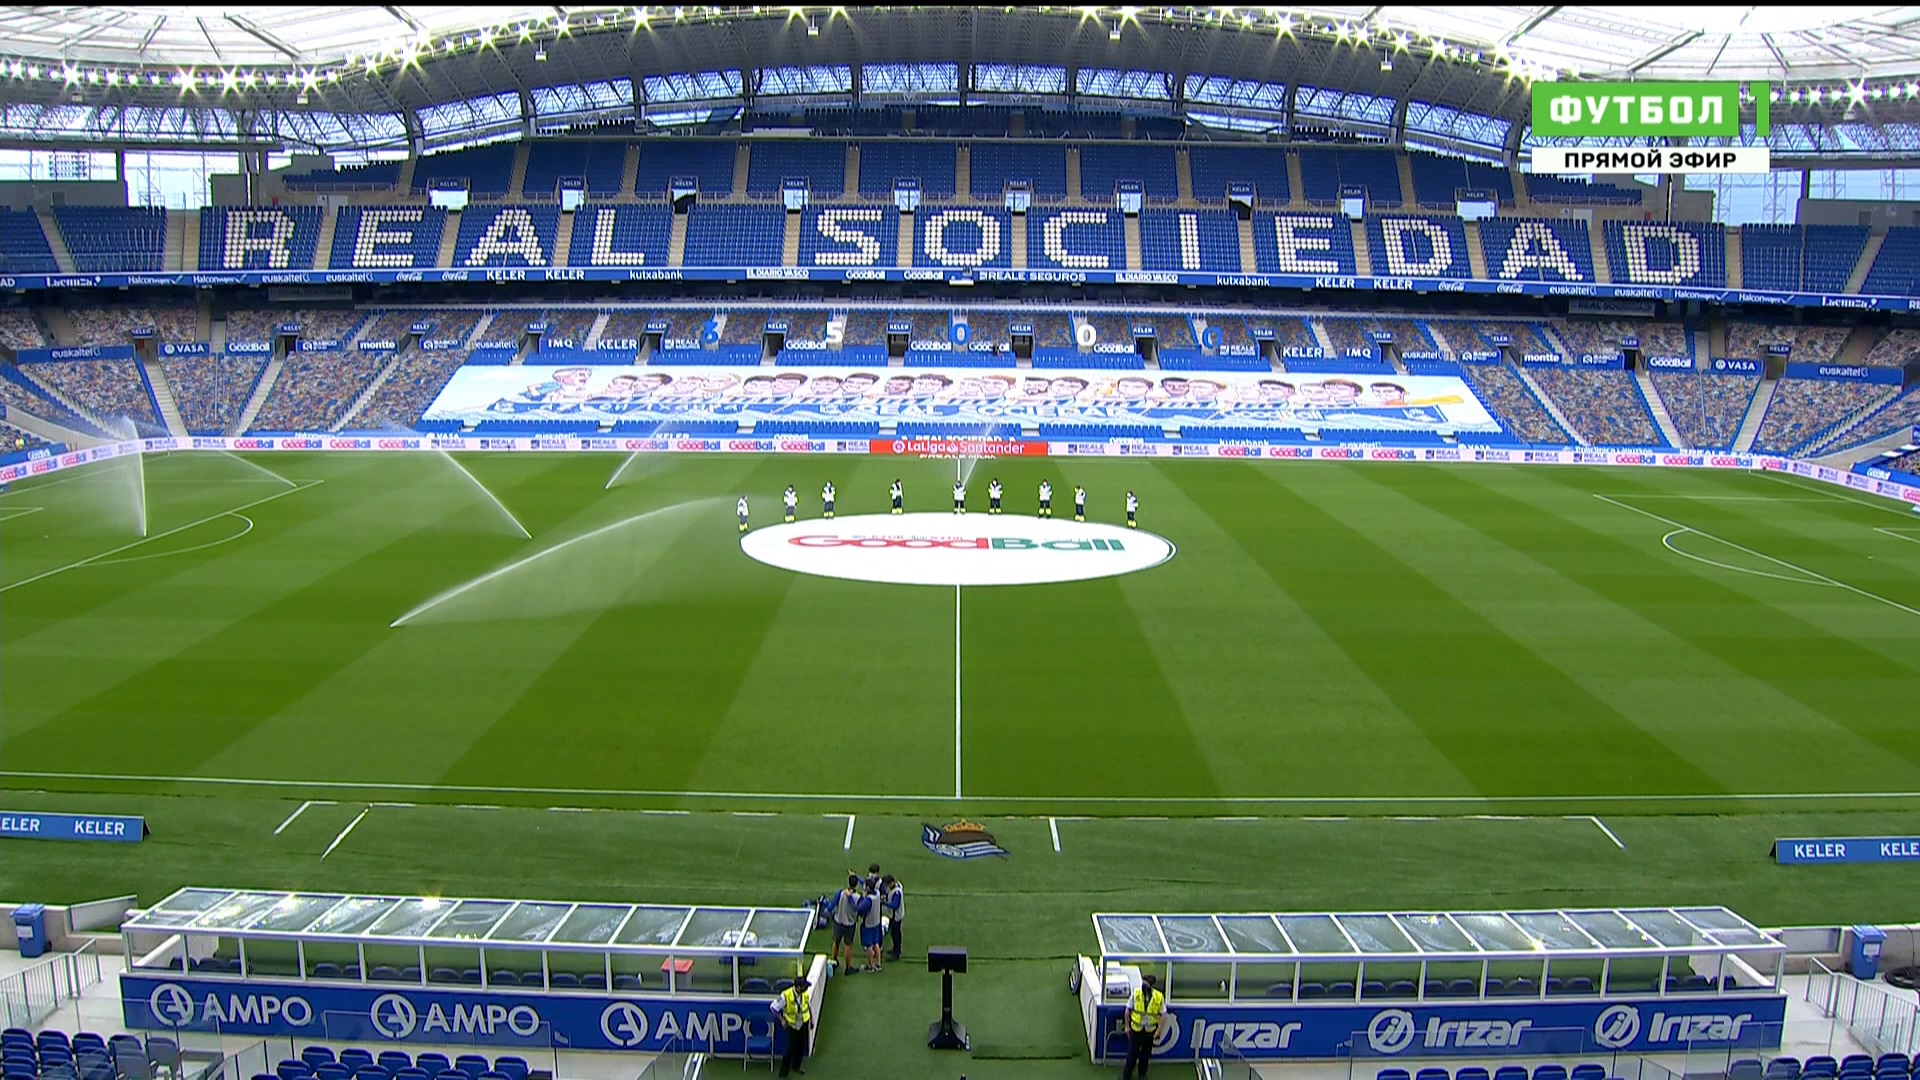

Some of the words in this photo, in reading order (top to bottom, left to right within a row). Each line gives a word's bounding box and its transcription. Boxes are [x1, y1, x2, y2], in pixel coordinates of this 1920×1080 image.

[223, 209, 645, 269] REAL
[814, 209, 1700, 283] SOCIEDAD
[262, 274, 303, 283] euskaltel
[326, 274, 366, 283] euskaltel
[486, 270, 526, 280] KELER
[545, 270, 585, 280] KELER
[629, 269, 684, 280] kutxabank
[845, 271, 885, 280] GoodBall
[904, 270, 943, 280] GoodBall
[988, 272, 1026, 281] REALE
[1030, 272, 1086, 281] SEGUROS
[1216, 275, 1270, 286] kutxabank
[1316, 278, 1355, 288] KELER
[1374, 279, 1413, 290] KELER
[1550, 286, 1590, 295] euskaltel
[1614, 289, 1655, 297] euskaltel
[826, 322, 843, 343] 5
[951, 323, 971, 346] 0
[1076, 324, 1097, 347] 0
[176, 344, 204, 353] VASA
[229, 342, 270, 353] GoodBall
[360, 341, 396, 350] montte
[598, 339, 637, 350] KELER
[786, 340, 827, 350] GoodBall
[911, 341, 951, 351] GoodBall
[969, 341, 1009, 351] Goodall
[1094, 344, 1135, 354] GoodBall
[1283, 347, 1323, 358] KELER
[1402, 351, 1438, 360] euskaltel
[1524, 354, 1560, 362] montte
[1651, 357, 1692, 368] GoodBall
[1728, 361, 1755, 370] VASA
[234, 440, 274, 449] GoodBall
[282, 440, 323, 449] GoodBall
[330, 440, 371, 449] GoodBall
[379, 440, 420, 449] GoodBall
[626, 440, 668, 450] GoodBall
[677, 441, 720, 450] GoodBall
[729, 441, 773, 450] GoodBall
[781, 441, 825, 451] GoodBall
[907, 441, 945, 453] LaLiga
[959, 441, 1025, 454] Santander
[1218, 446, 1262, 456] GoodBall
[1270, 448, 1312, 457] GoodBall
[1321, 449, 1363, 458] GoodBall
[1372, 450, 1414, 459] GoodBall
[1616, 455, 1656, 465] GoodBall
[1663, 456, 1704, 466] GoodBall
[1711, 456, 1752, 467] GoodBall
[788, 535, 1125, 550] GoodBall
[0, 817, 40, 832] ELER
[74, 820, 125, 836] KELER
[1795, 843, 1846, 858] KELER
[1880, 842, 1920, 856] KELE
[202, 992, 313, 1027] AMPO
[422, 1002, 540, 1037] AMPO
[1424, 1016, 1533, 1048] Irizar
[1649, 1013, 1752, 1042] Irizar
[1190, 1019, 1301, 1049] Irizar
